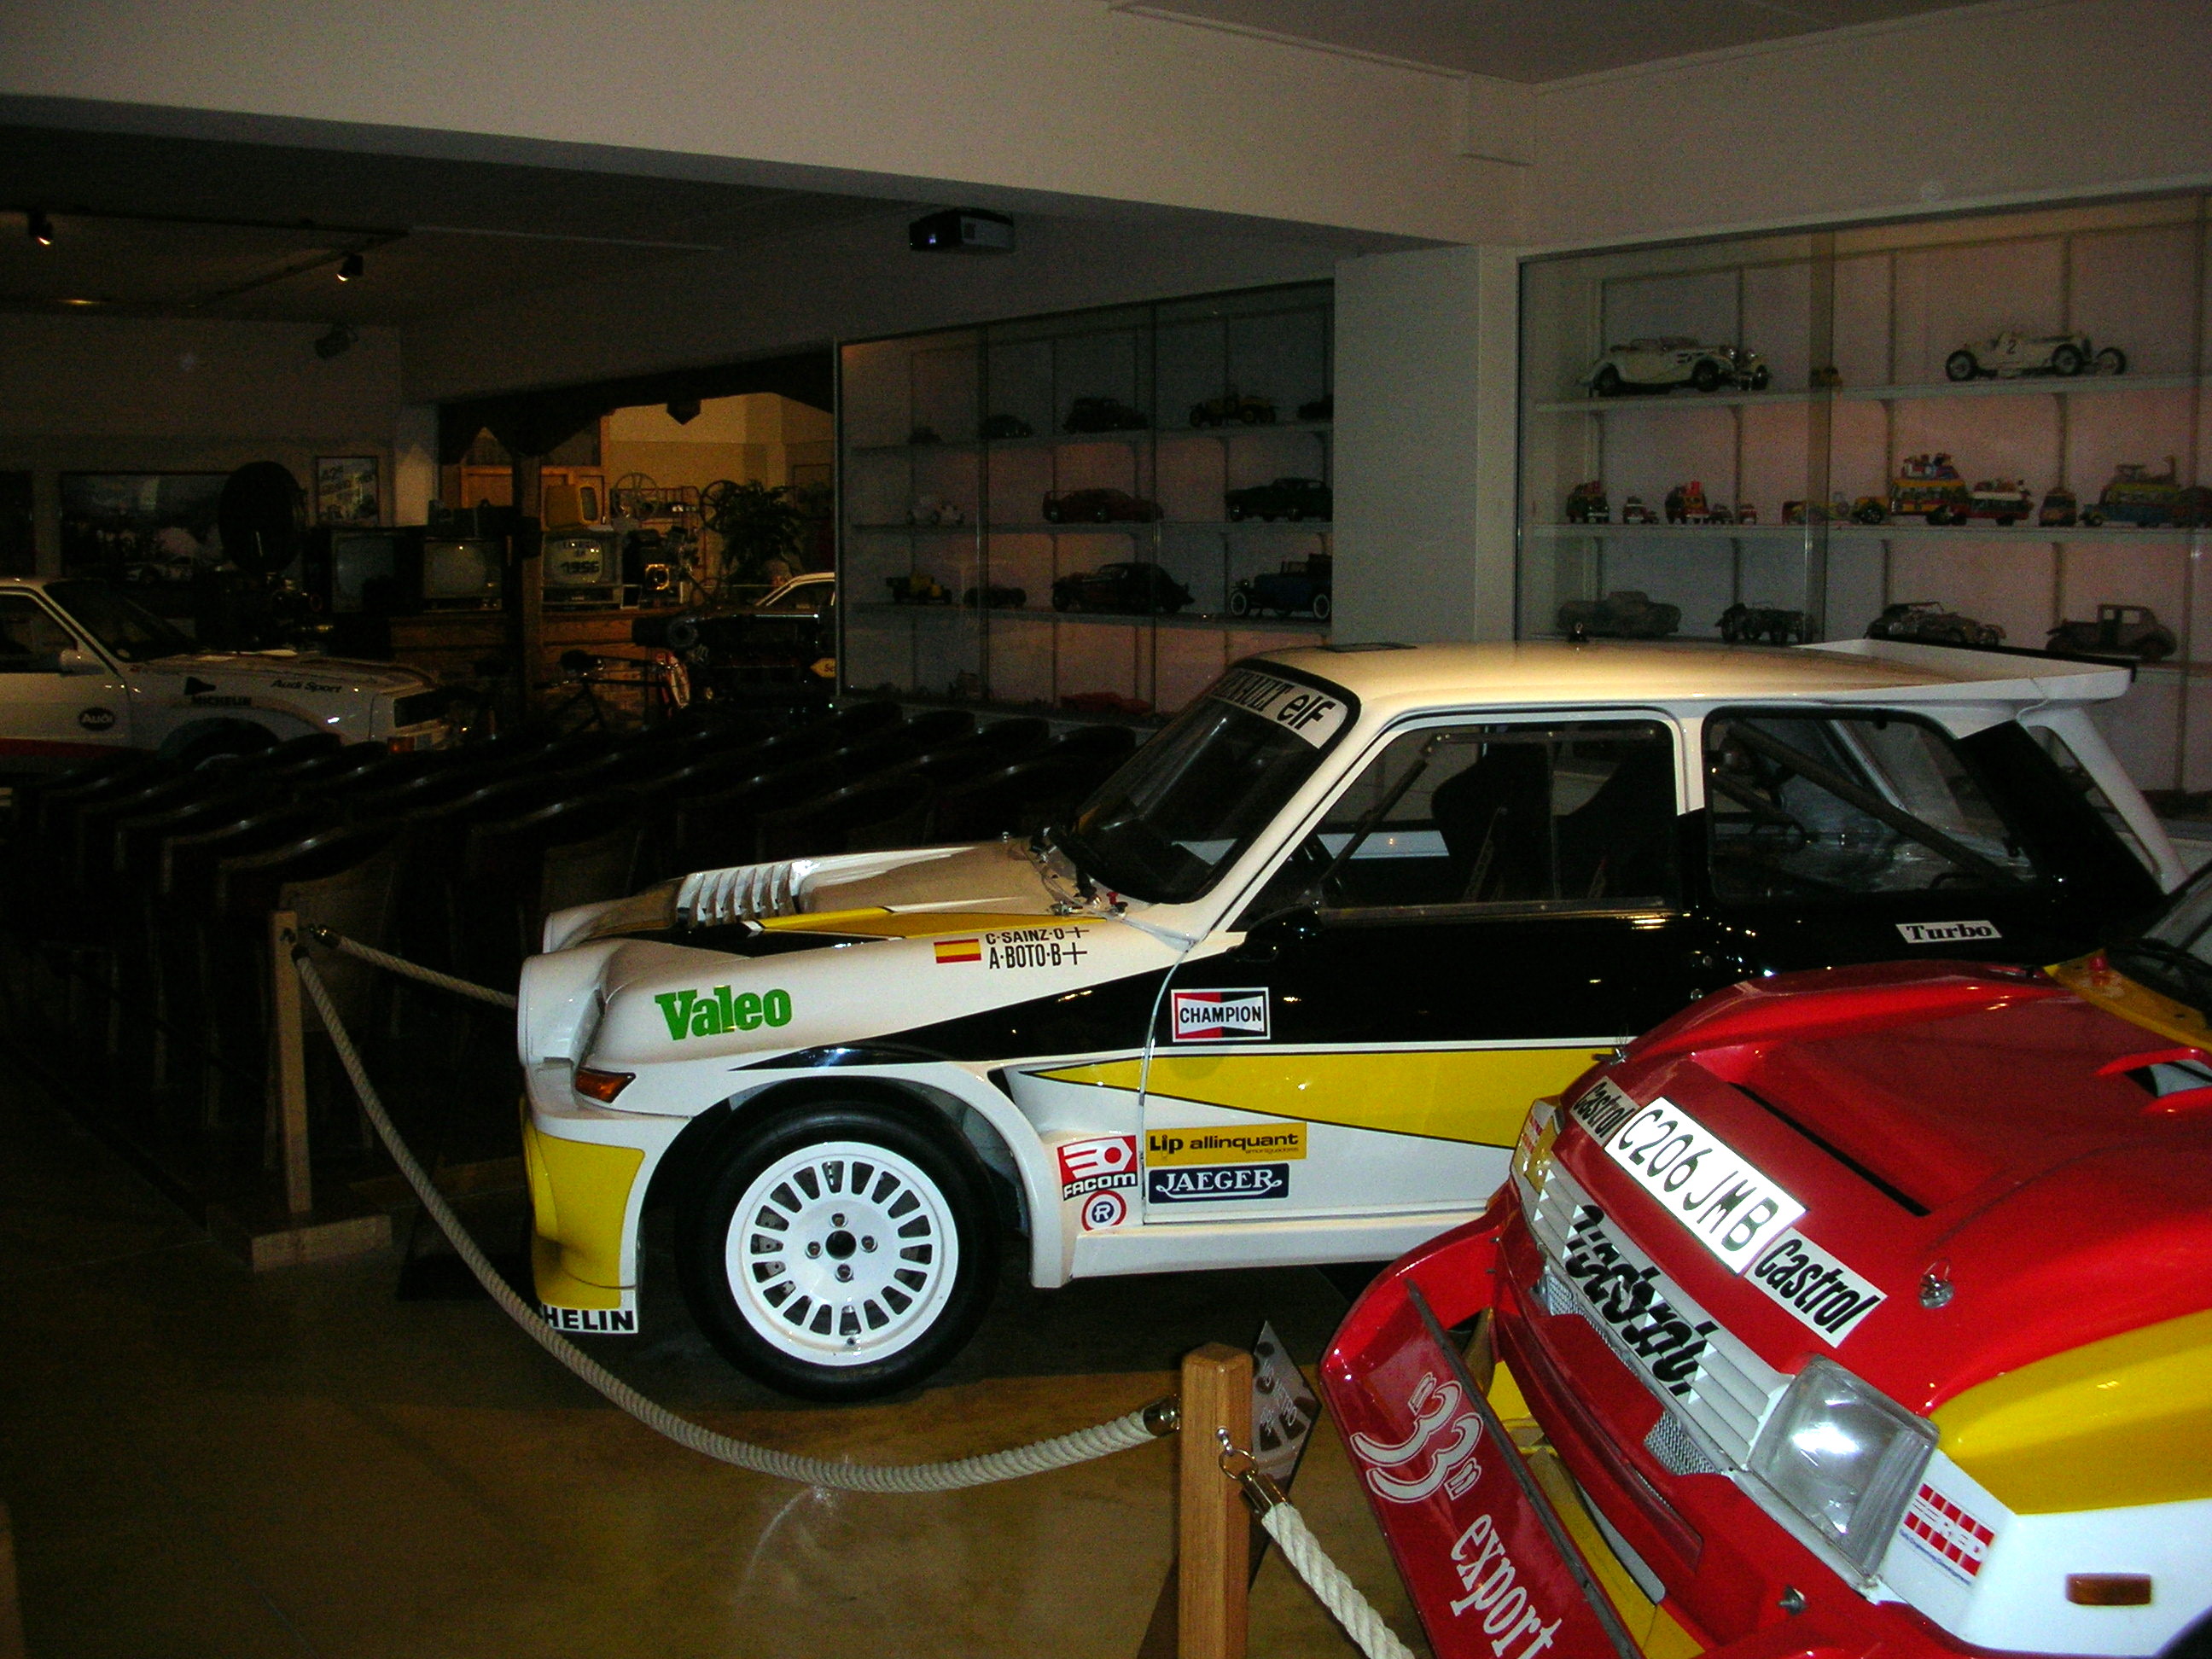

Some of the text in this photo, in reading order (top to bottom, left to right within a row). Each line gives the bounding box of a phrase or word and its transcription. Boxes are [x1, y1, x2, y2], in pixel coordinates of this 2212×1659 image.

[271, 679, 341, 693] Audi Sport
[81, 713, 113, 724] Audi
[1277, 694, 1336, 730] elf
[1906, 923, 1993, 940] Turbo
[655, 985, 792, 1040] Valeo
[1179, 1006, 1262, 1023] CHAMPION
[1574, 1082, 1635, 1138] Castrol
[1150, 1133, 1298, 1154] Lip allinquant
[1063, 1173, 1137, 1196] FACOM
[1155, 1169, 1282, 1191] JAEGER
[1754, 1238, 1880, 1334] Castrol
[1451, 1514, 1562, 1659] export
